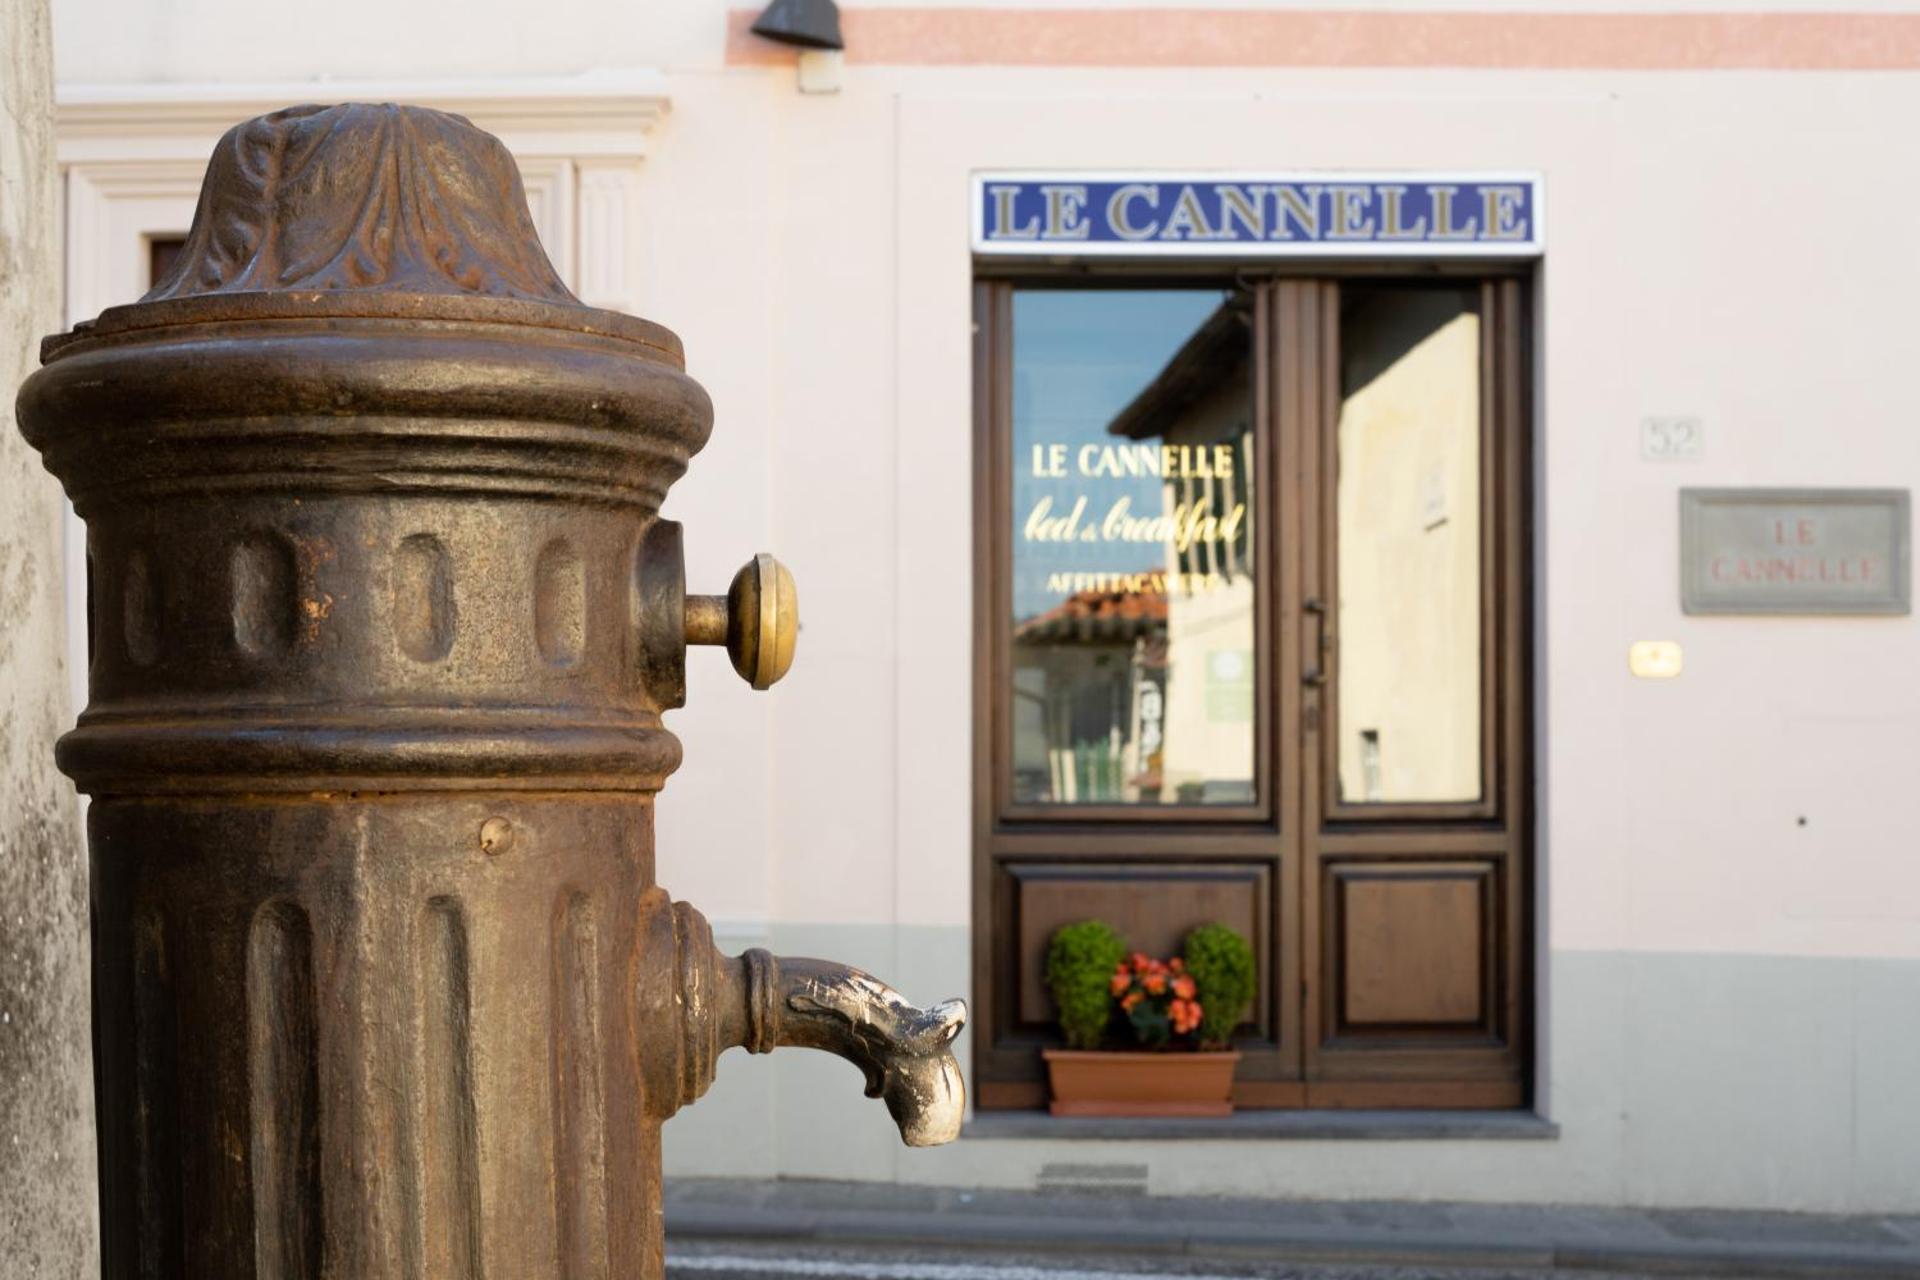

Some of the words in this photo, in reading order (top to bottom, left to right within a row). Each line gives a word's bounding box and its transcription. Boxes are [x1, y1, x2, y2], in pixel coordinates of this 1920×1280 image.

[988, 185, 1090, 240] LE
[1105, 184, 1527, 240] CANNELLE
[1648, 420, 1696, 456] 52
[1032, 444, 1068, 478] LE
[1078, 444, 1234, 478] CANNELLE
[1024, 496, 1088, 542] bed
[1774, 518, 1816, 545] LE
[1710, 555, 1880, 583] CANNELLE
